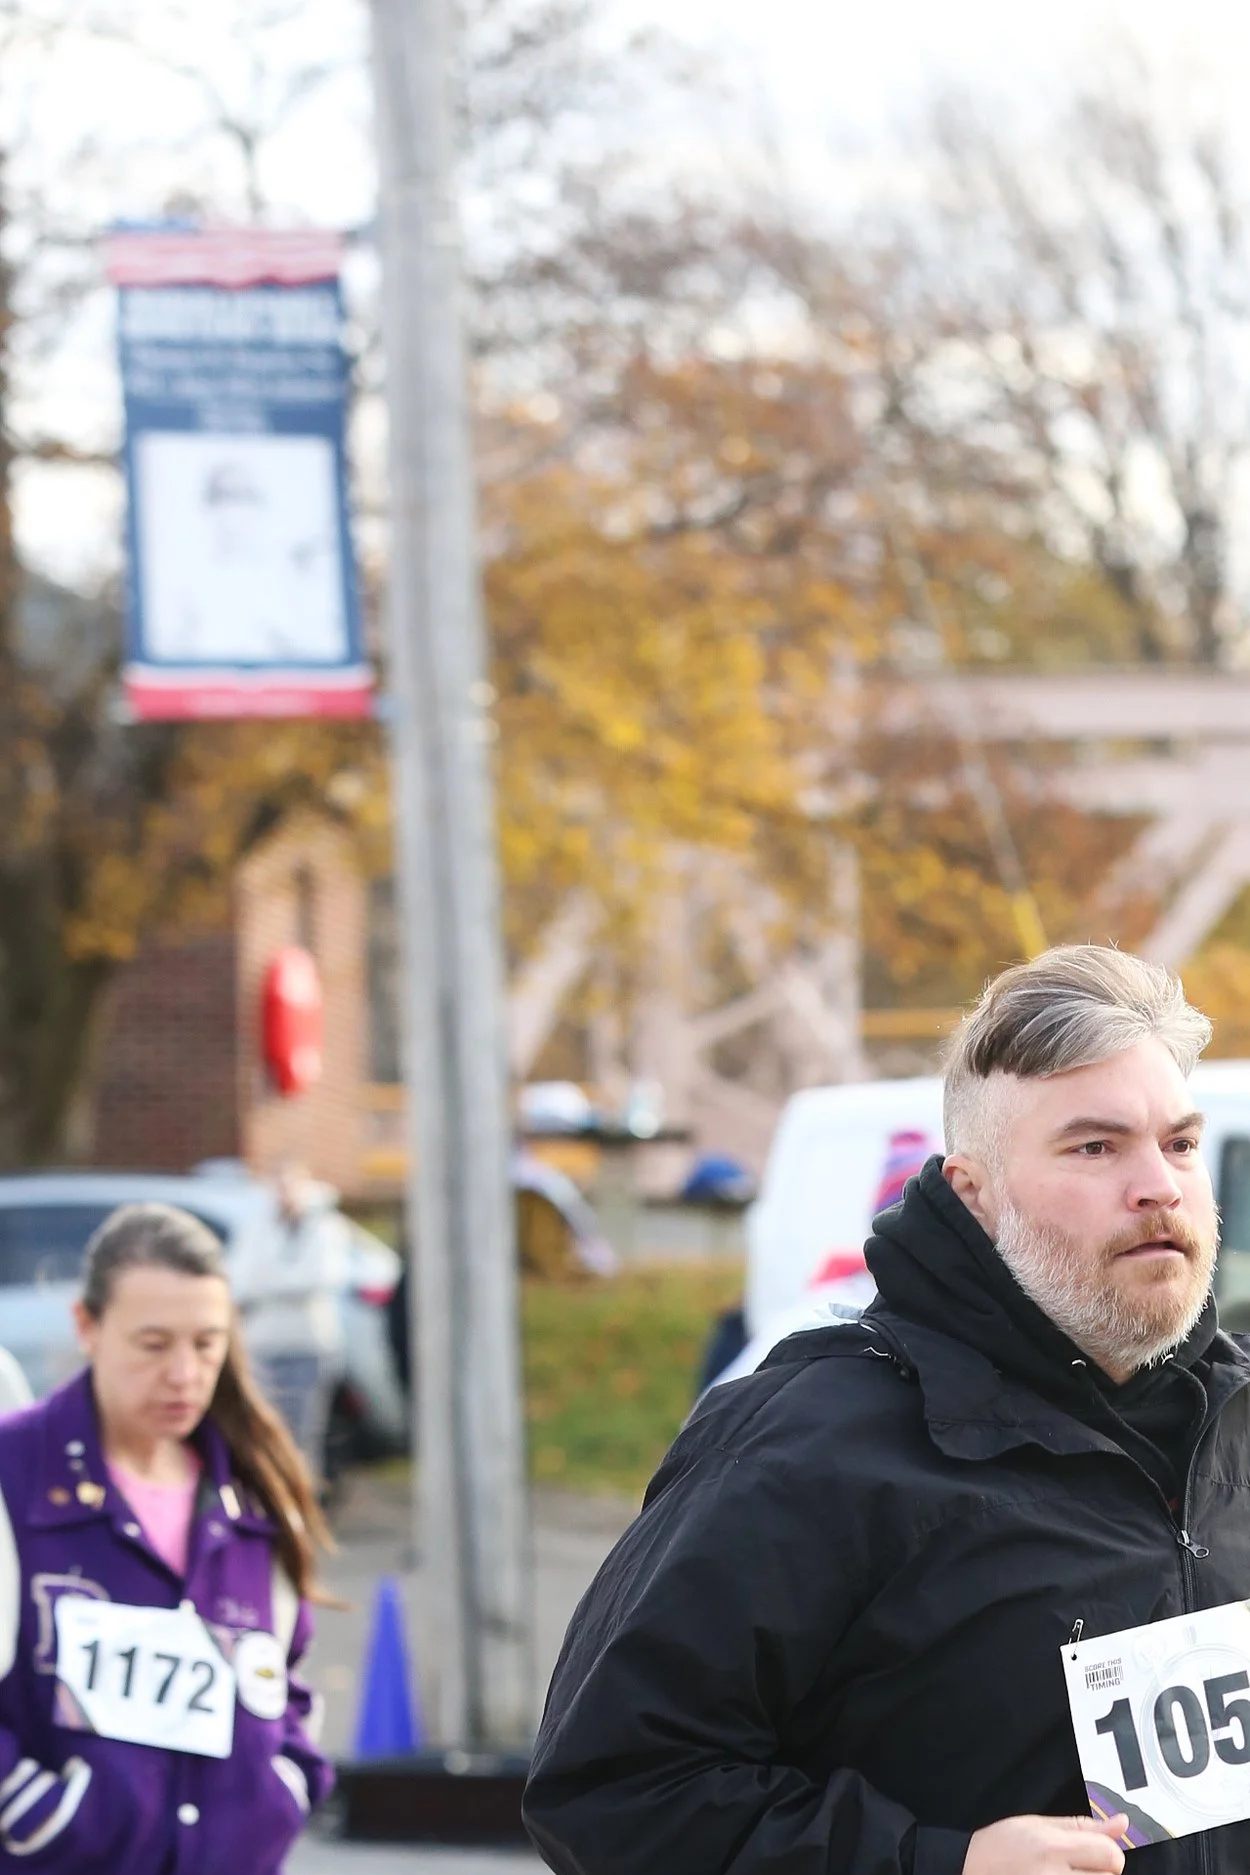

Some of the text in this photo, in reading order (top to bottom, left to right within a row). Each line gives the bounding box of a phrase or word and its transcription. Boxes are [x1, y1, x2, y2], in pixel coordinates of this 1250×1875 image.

[1107, 1656, 1122, 1668] THIS
[80, 1639, 216, 1714] 1172
[1090, 1677, 1121, 1692] TIMING
